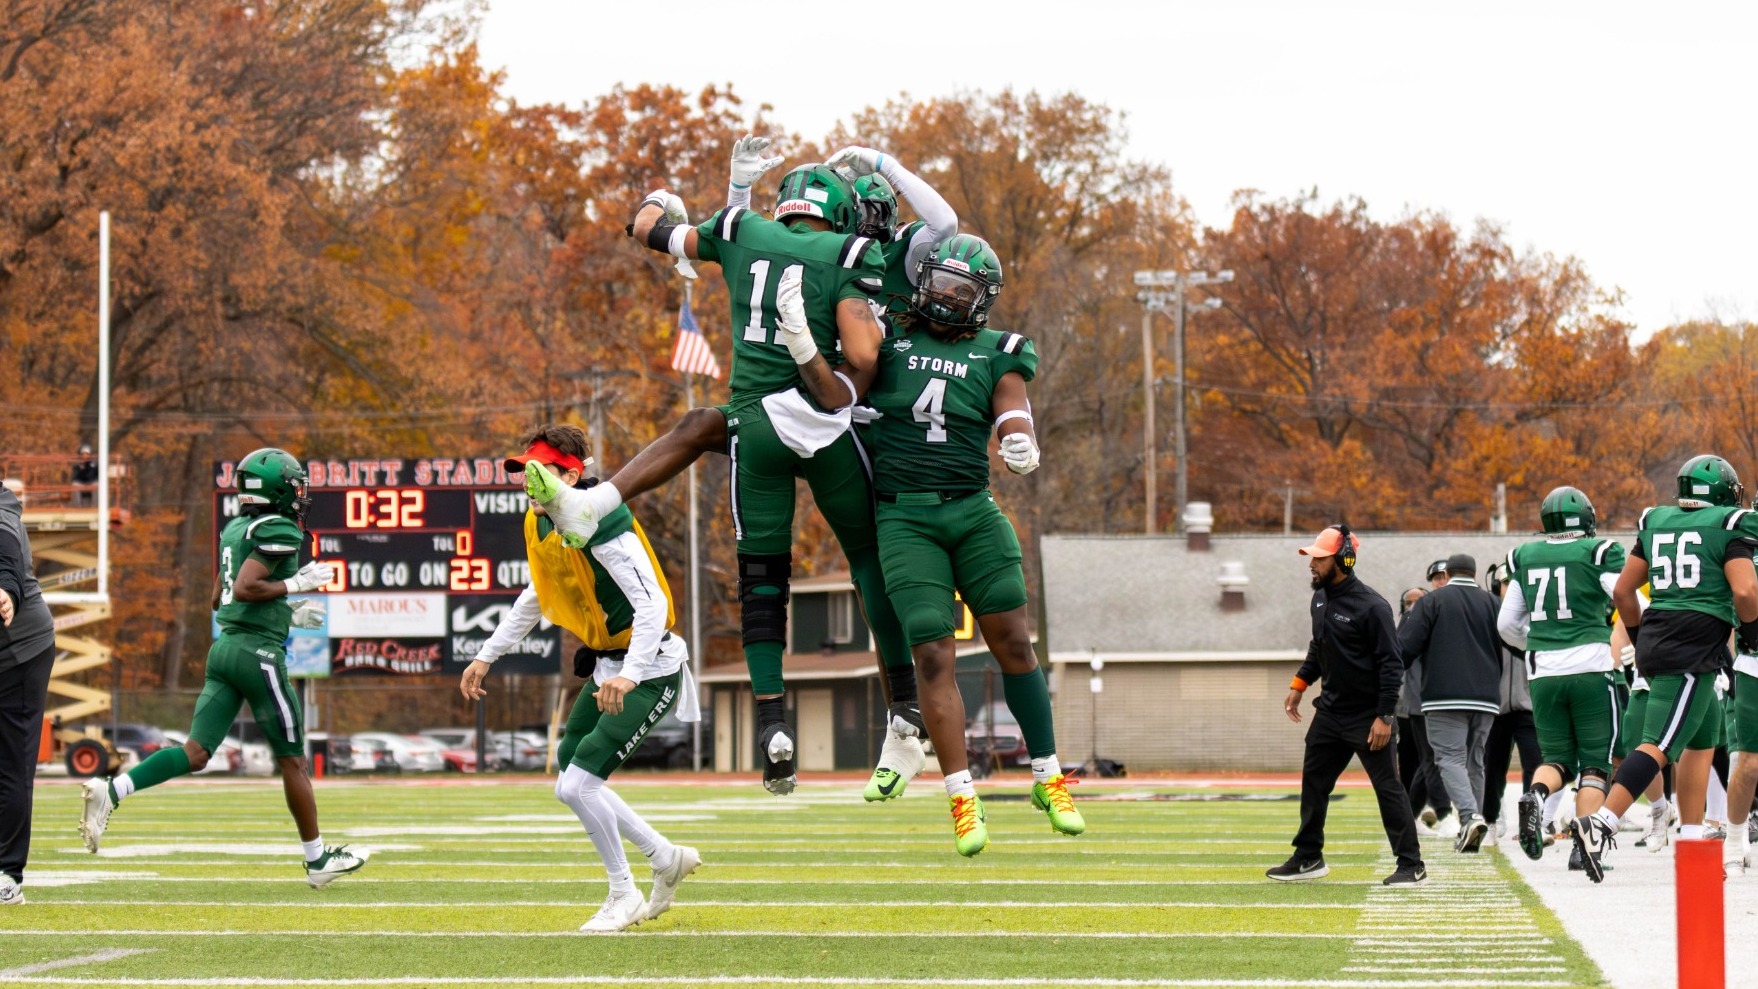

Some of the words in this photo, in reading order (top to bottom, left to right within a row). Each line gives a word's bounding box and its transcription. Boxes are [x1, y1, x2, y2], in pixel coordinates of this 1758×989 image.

[779, 202, 811, 215] Riddell
[908, 355, 968, 378] STORM
[912, 377, 948, 442] 4
[307, 460, 403, 487] BRITT
[415, 459, 526, 485] STADI
[345, 489, 425, 528] 0:32
[474, 491, 530, 514] VISIT
[320, 537, 341, 553] TOL
[432, 536, 455, 552] TOL
[456, 530, 471, 556] 0
[1652, 531, 1702, 590] 56
[348, 561, 375, 587] TO
[381, 561, 409, 587] GO
[419, 561, 447, 586] ON
[450, 558, 491, 590] 23
[1527, 566, 1573, 621] 71
[334, 638, 378, 661] RED
[380, 640, 441, 662] CREEK
[616, 722, 648, 760] LAKE
[648, 686, 676, 723] ERIE
